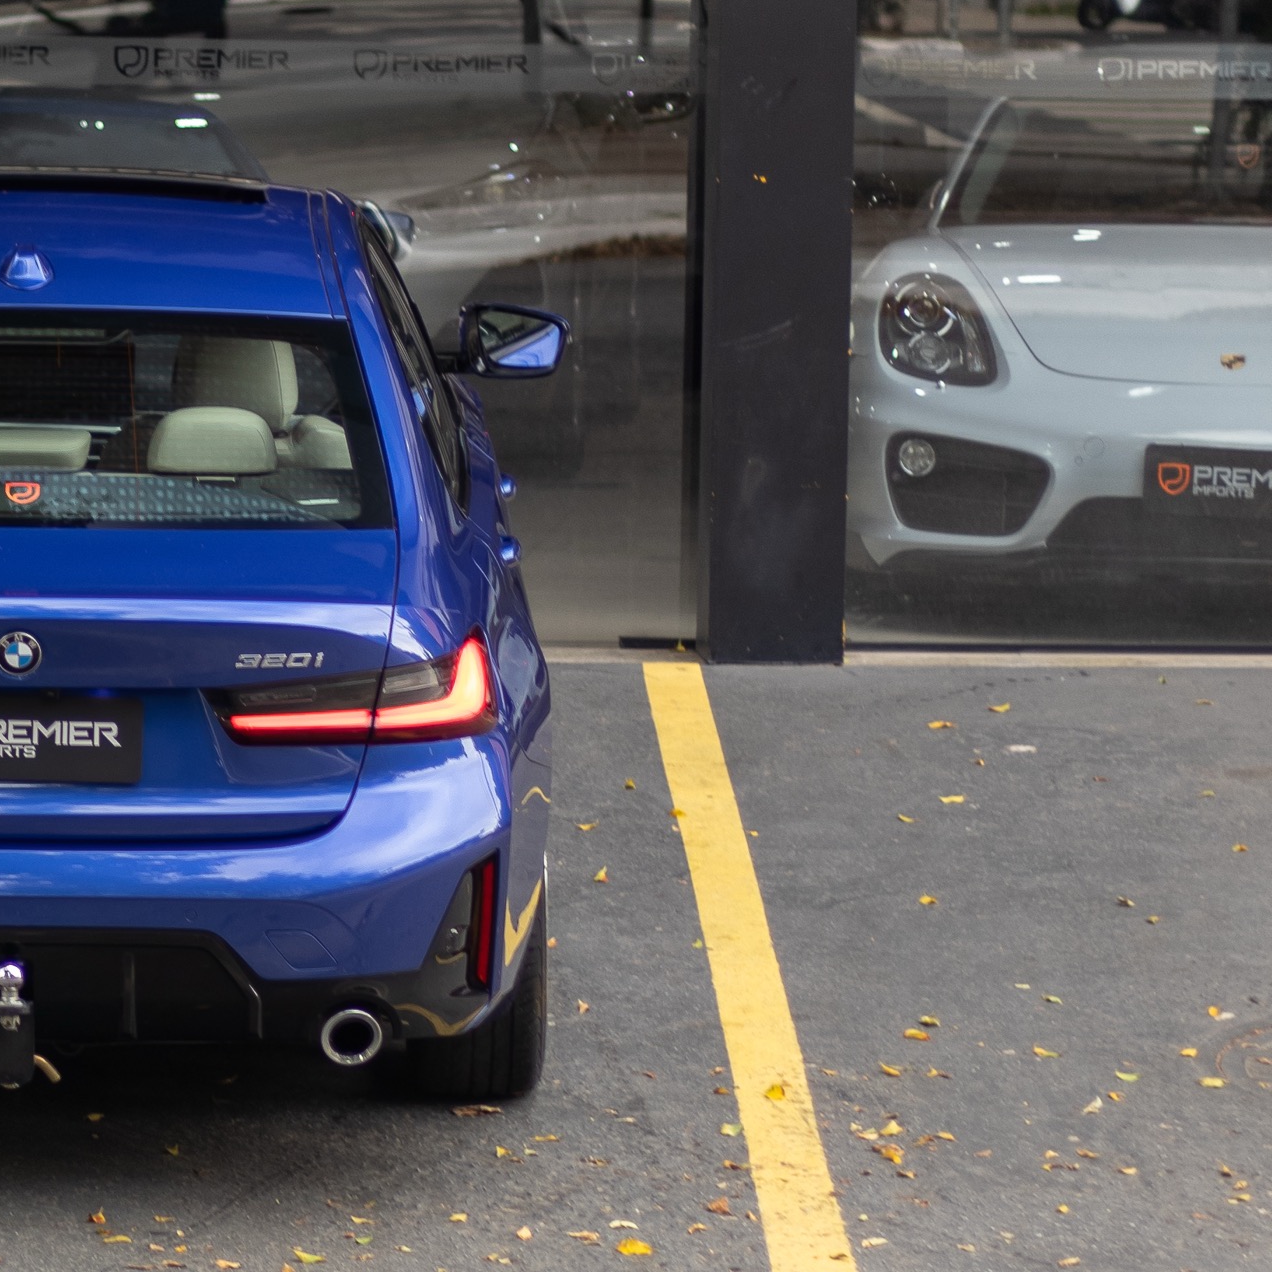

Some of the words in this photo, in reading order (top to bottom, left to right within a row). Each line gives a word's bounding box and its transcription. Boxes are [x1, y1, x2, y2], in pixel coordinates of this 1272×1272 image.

[154, 48, 290, 70] PREMIER
[392, 54, 530, 74] PREMIER
[1192, 485, 1255, 499] IMPORTS
[235, 651, 325, 669] 320i
